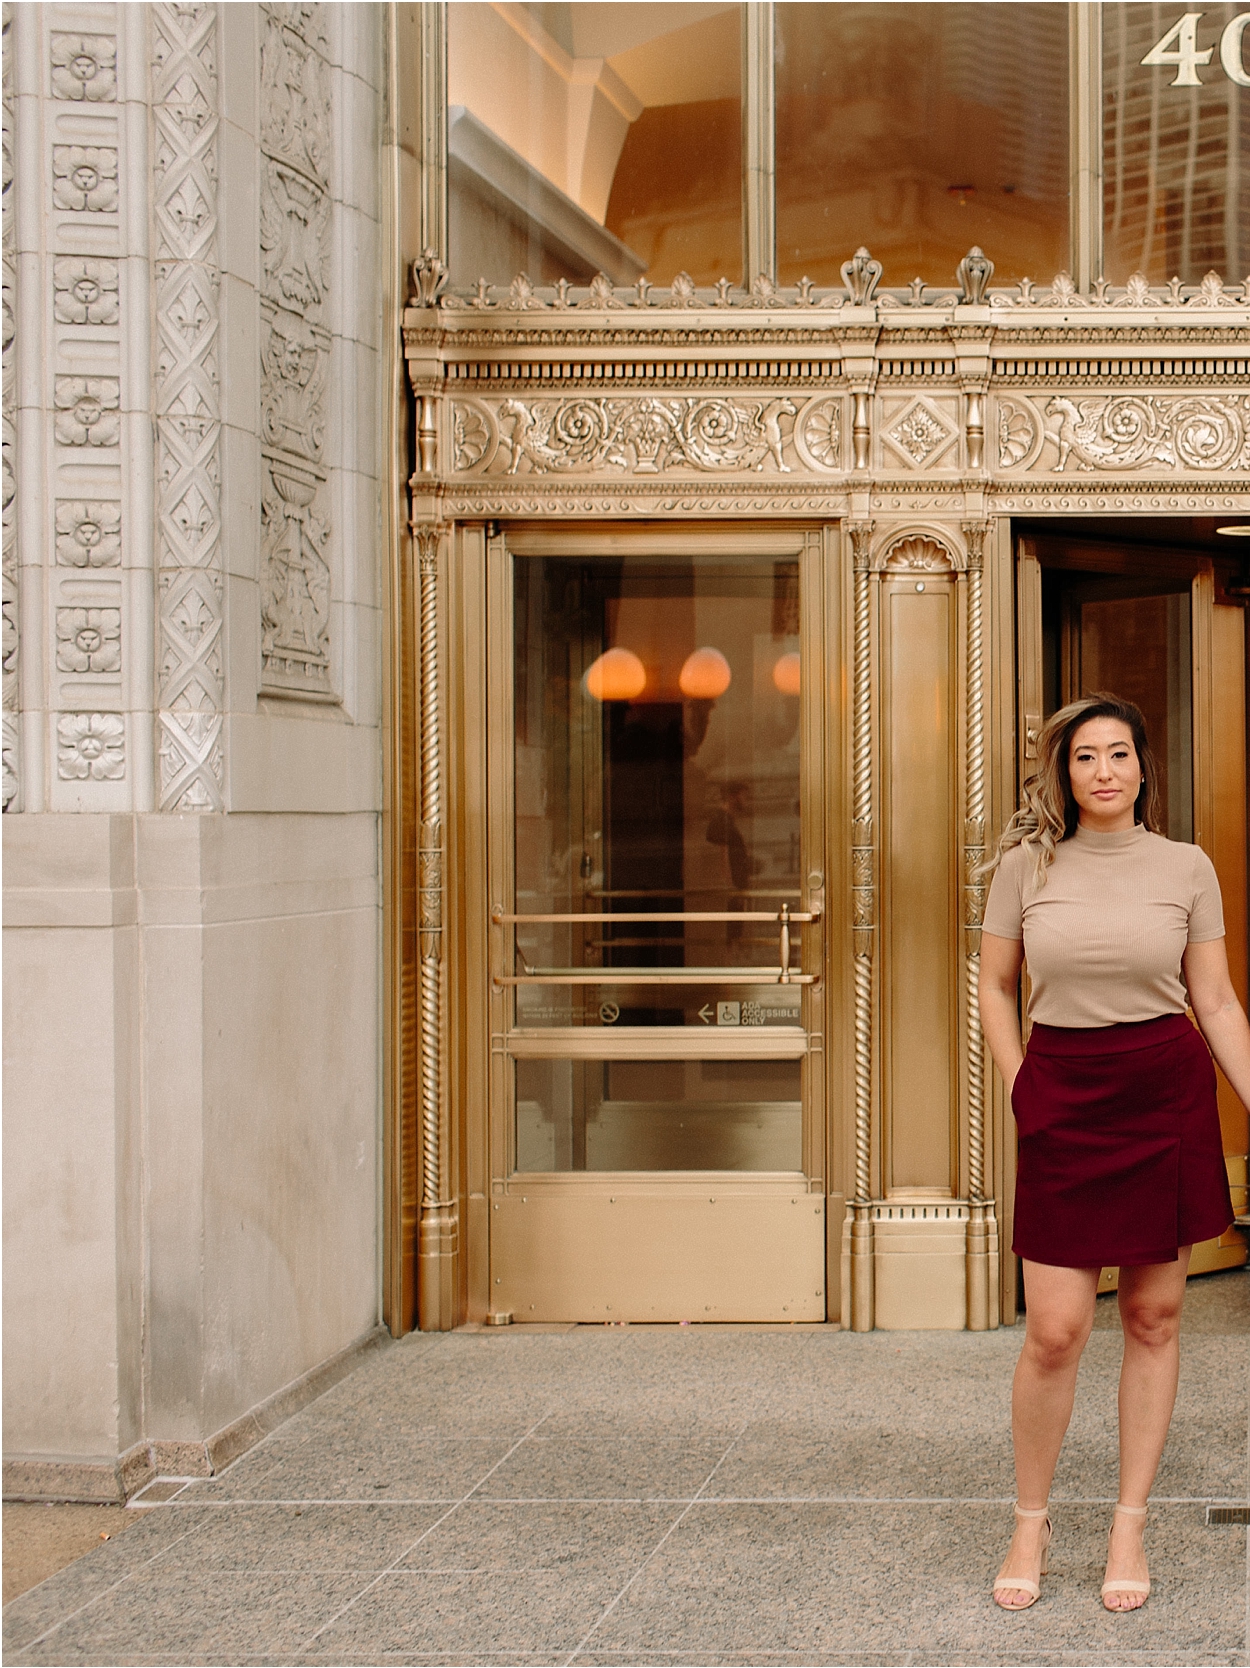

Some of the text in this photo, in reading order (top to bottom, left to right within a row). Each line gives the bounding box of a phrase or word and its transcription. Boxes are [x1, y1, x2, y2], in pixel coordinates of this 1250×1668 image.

[741, 1001, 761, 1010] ADA
[741, 1009, 799, 1018] ACCESSIBLE
[741, 1016, 766, 1025] ONLY
